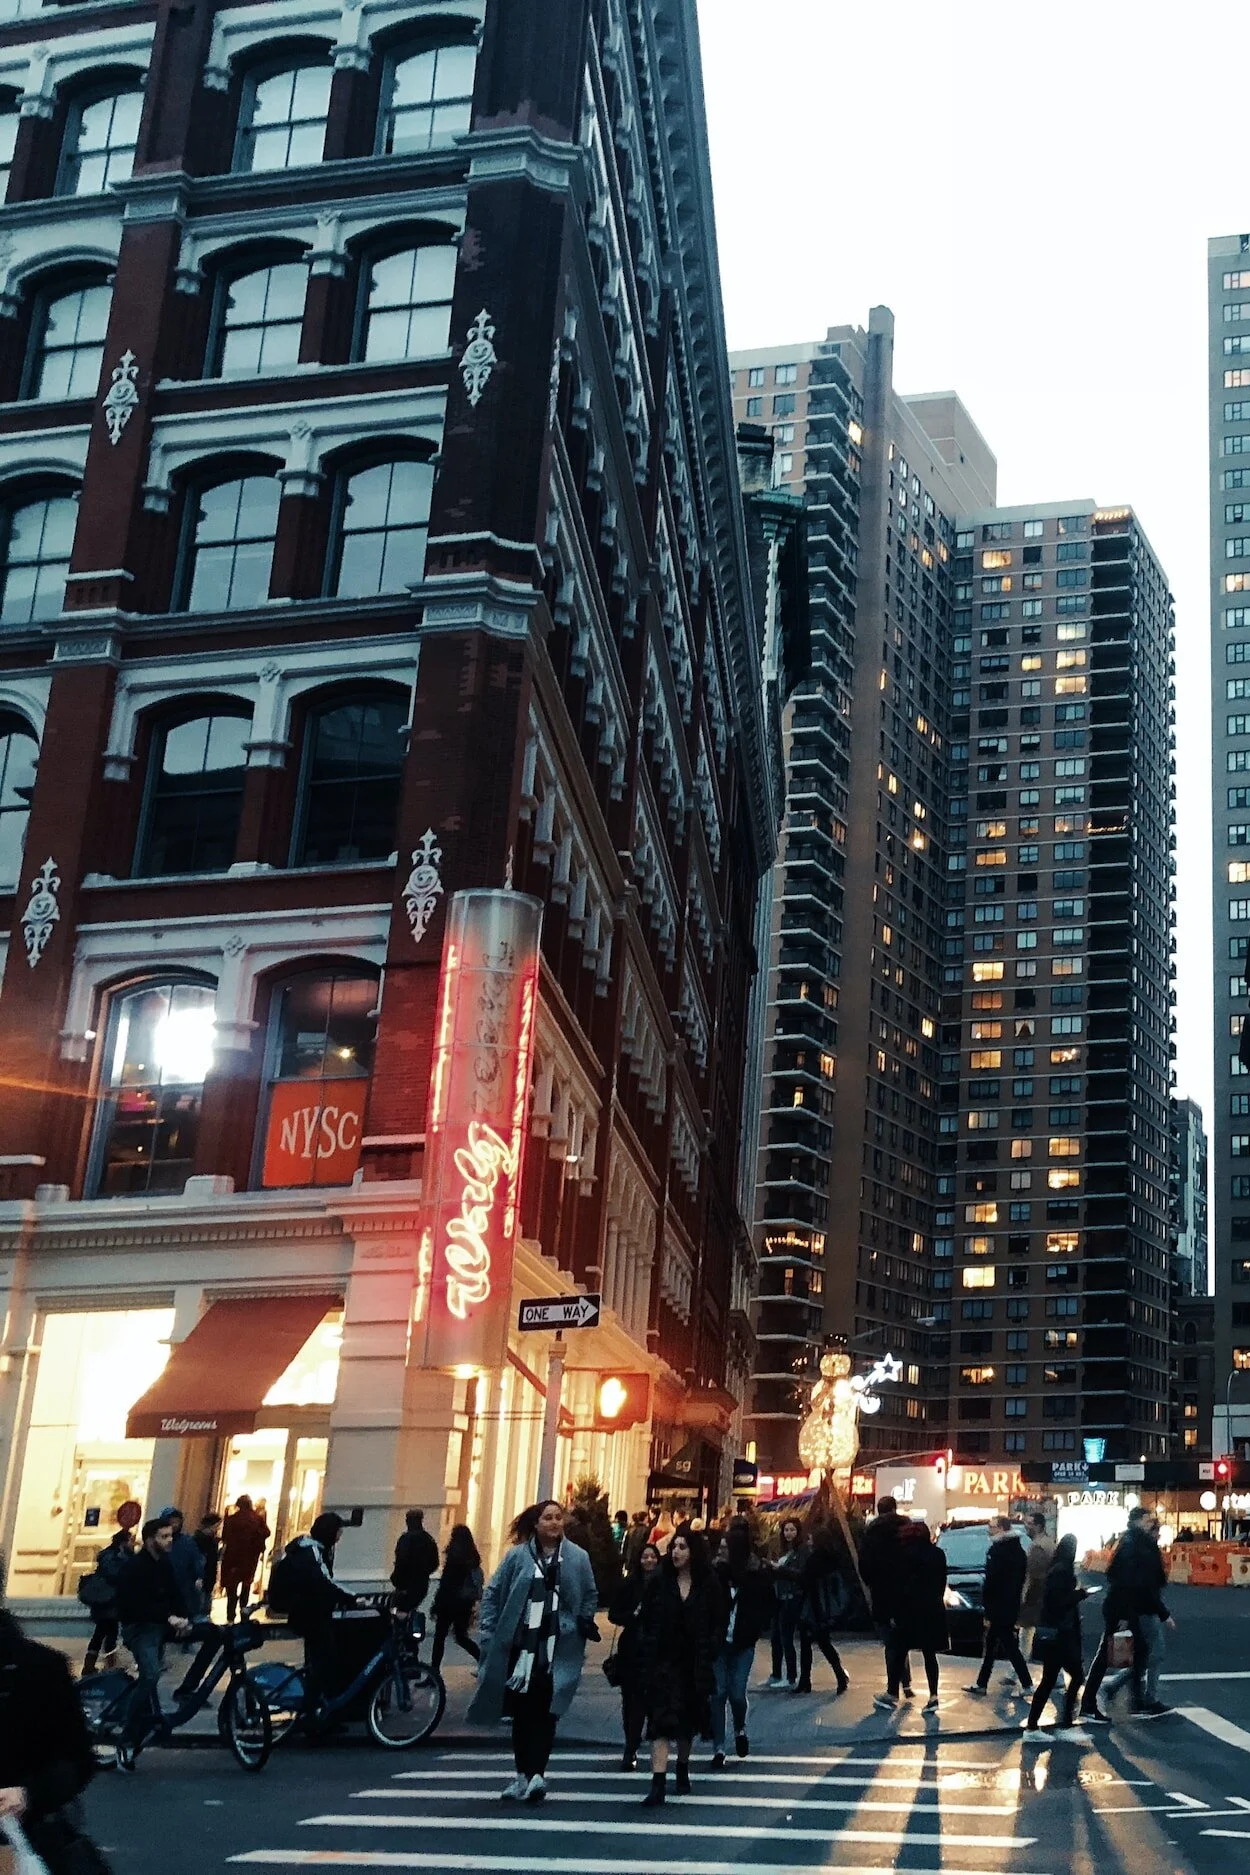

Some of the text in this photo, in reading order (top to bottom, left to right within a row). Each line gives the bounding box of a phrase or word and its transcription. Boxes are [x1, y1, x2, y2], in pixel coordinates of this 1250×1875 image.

[280, 1106, 359, 1158] NYSC
[525, 1304, 589, 1320] ONE WAY
[161, 1418, 218, 1434] Walgreens
[1052, 1462, 1081, 1471] PARK
[777, 1476, 807, 1496] SOUP
[963, 1471, 1026, 1494] PARK
[1067, 1490, 1120, 1506] PARK
